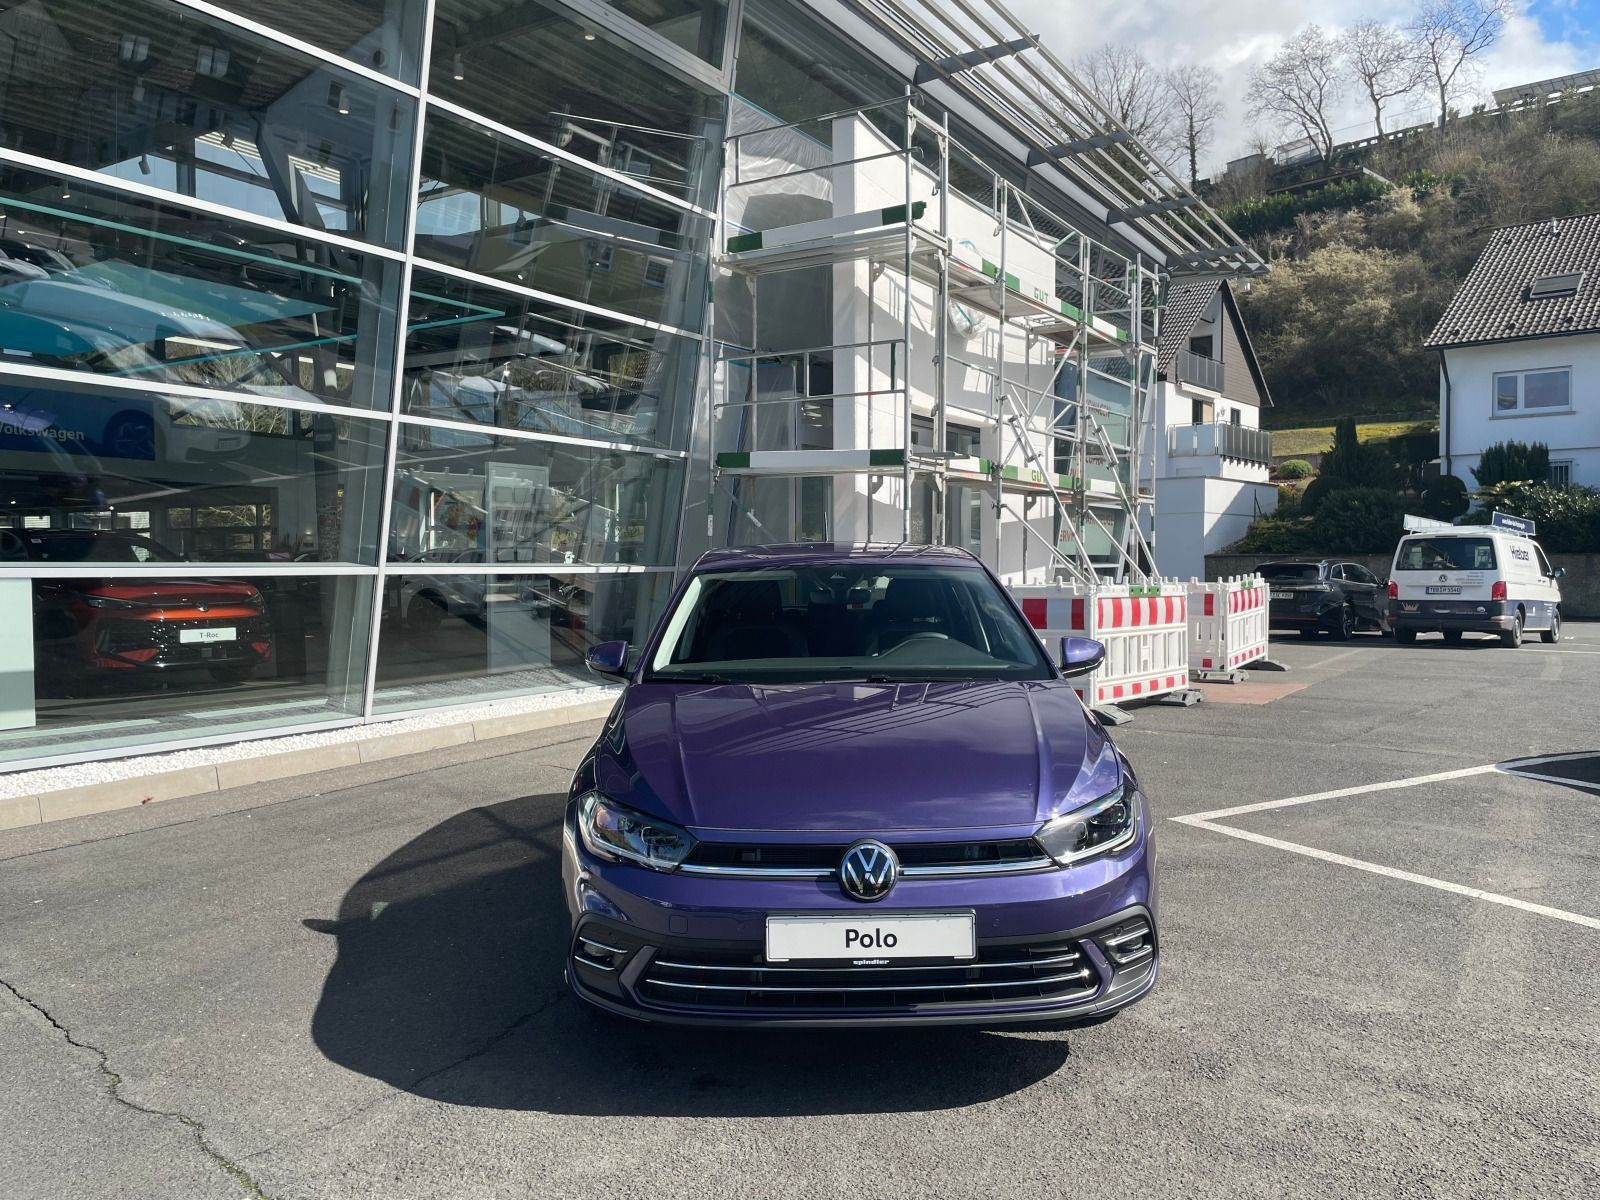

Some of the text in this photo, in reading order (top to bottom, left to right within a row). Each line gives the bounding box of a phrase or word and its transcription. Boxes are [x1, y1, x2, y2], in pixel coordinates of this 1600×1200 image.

[1033, 287, 1049, 304] GUT
[1031, 470, 1043, 483] GU
[845, 928, 898, 948] Polo
